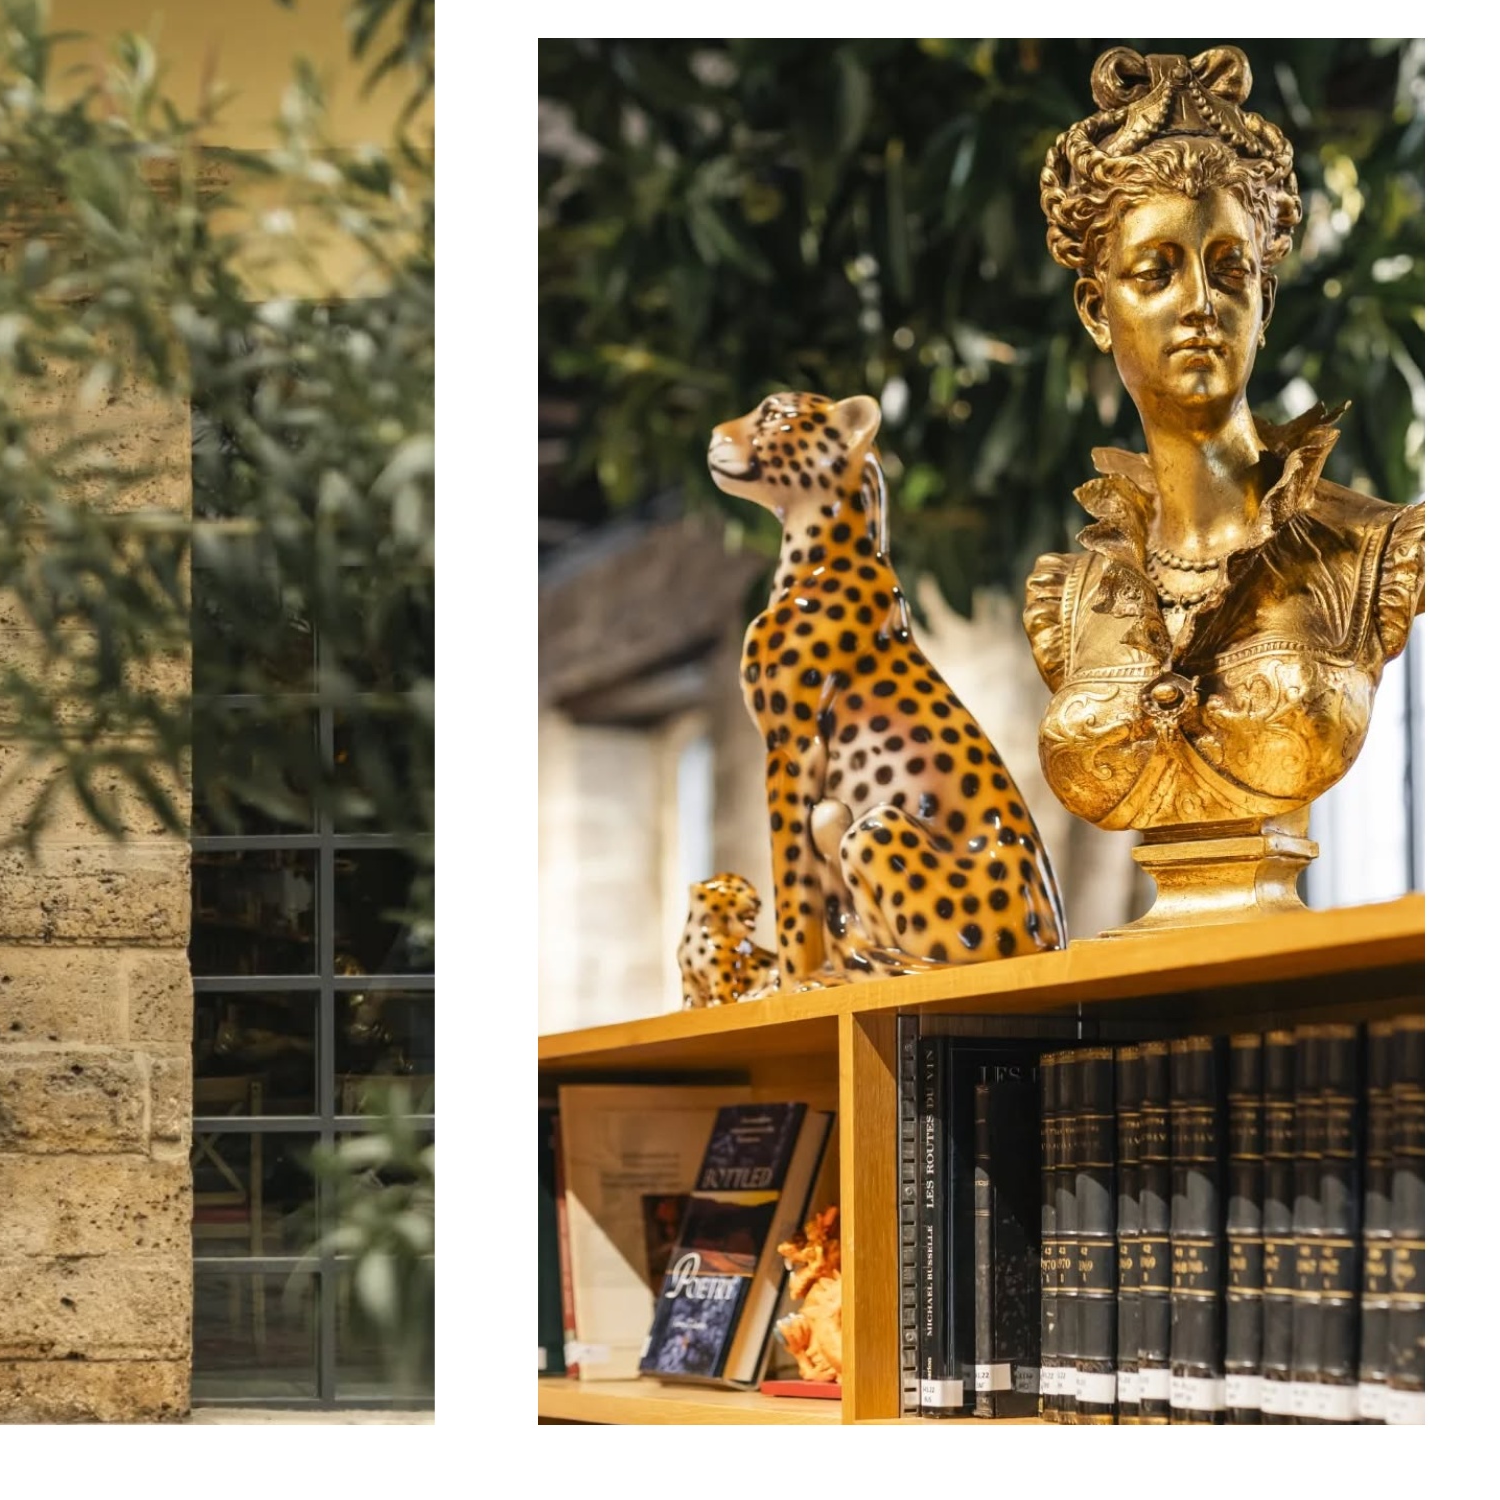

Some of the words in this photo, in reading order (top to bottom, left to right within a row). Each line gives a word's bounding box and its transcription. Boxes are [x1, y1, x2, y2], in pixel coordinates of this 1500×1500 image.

[924, 1049, 935, 1080] VIN
[925, 1088, 935, 1108] DU
[926, 1115, 935, 1174] ROUTES
[702, 1166, 774, 1189] BOTTLED
[927, 1181, 935, 1209] LES
